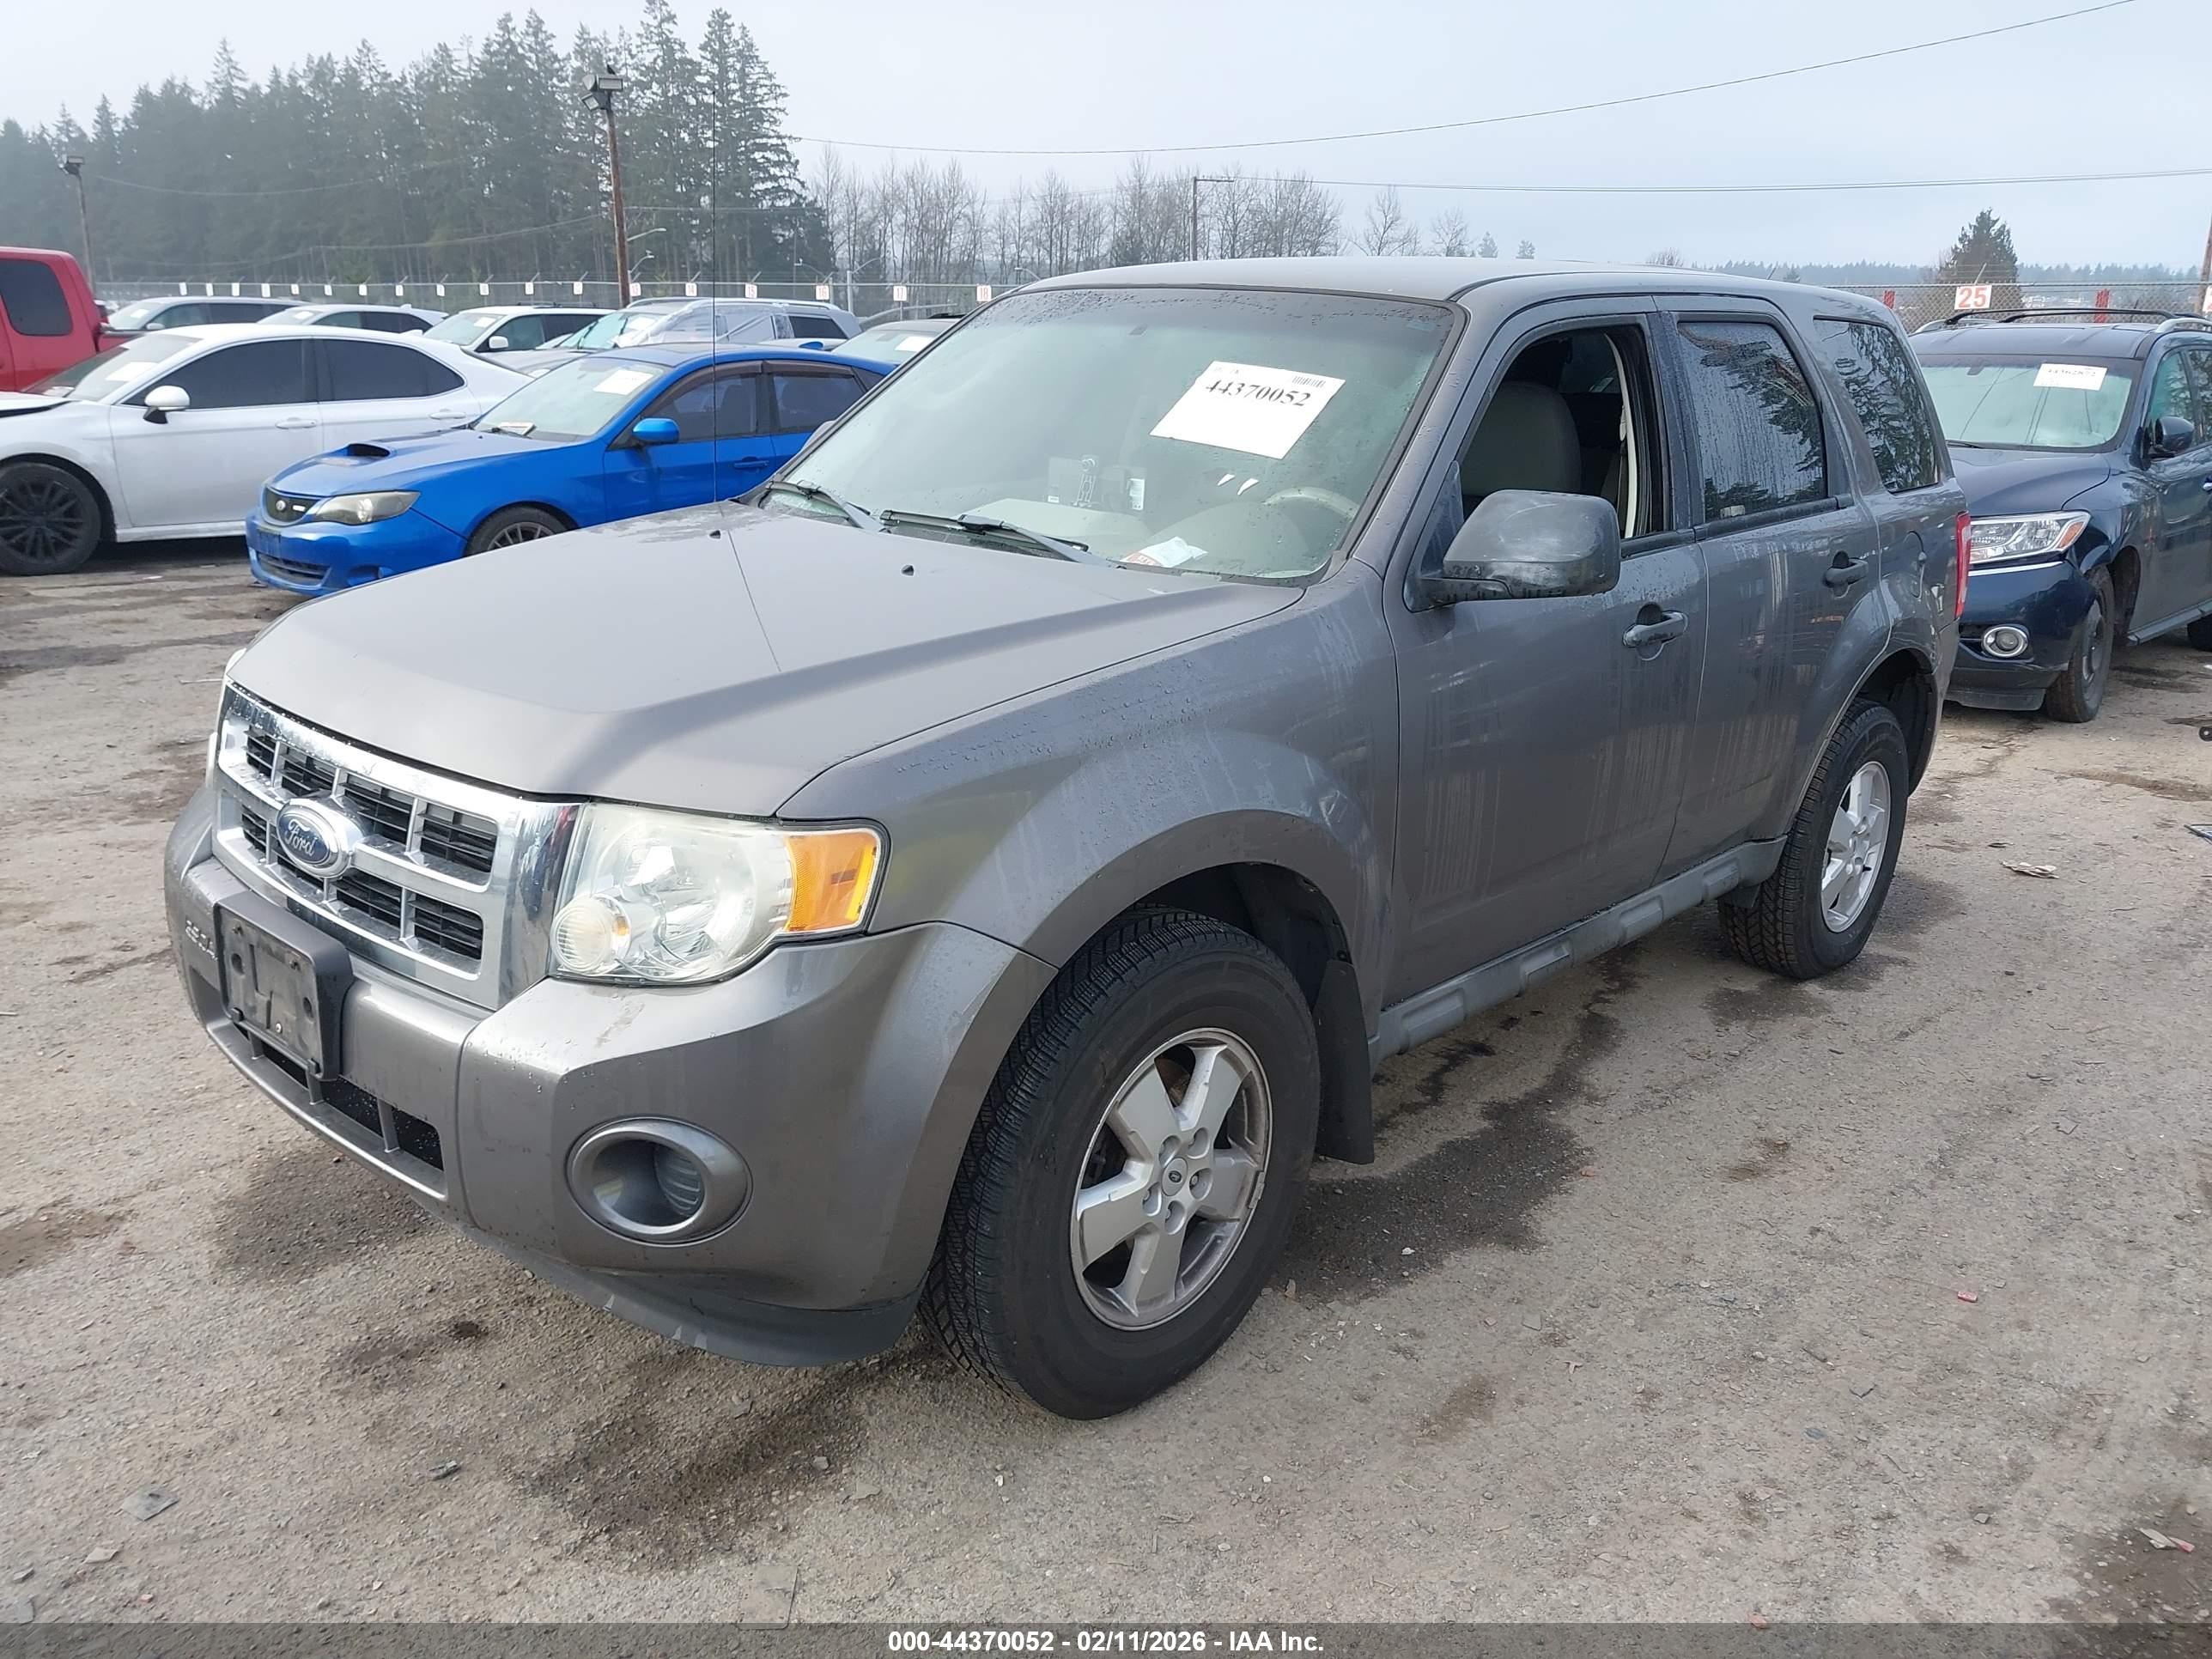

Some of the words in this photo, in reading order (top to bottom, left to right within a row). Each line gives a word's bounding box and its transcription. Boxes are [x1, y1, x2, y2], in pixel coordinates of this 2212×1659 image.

[979, 287, 988, 299] 18
[1958, 288, 1987, 307] 25
[1206, 380, 1311, 406] 44370052
[284, 818, 318, 857] Ford
